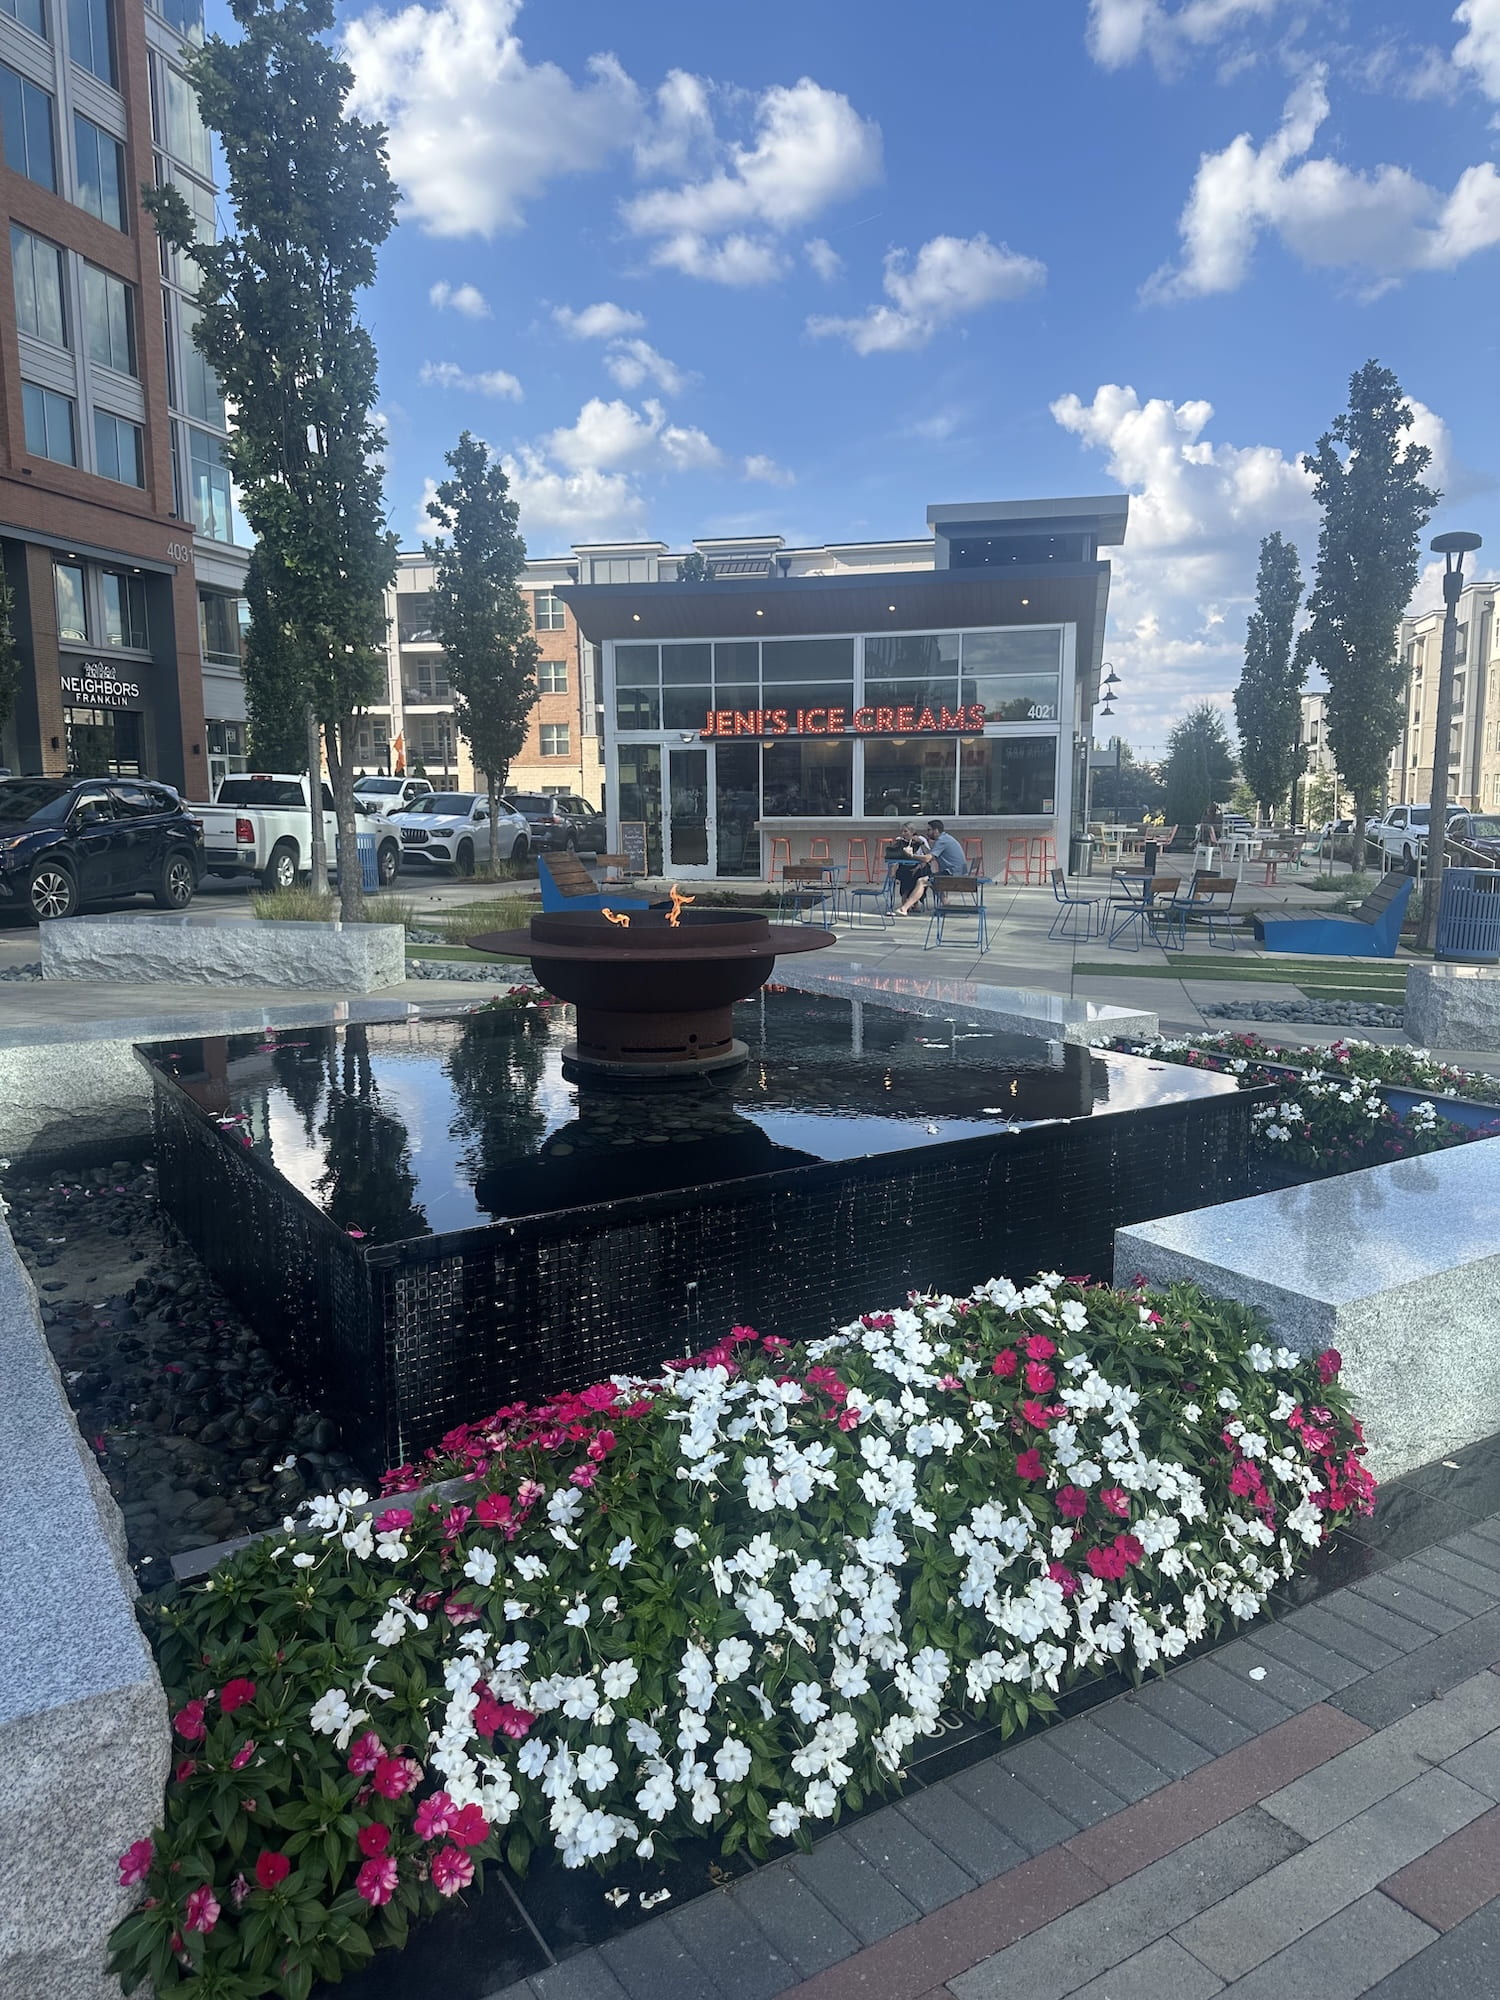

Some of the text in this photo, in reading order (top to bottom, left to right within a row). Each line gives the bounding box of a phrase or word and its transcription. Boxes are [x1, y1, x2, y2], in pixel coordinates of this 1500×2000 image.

[167, 541, 193, 563] 4031
[61, 676, 139, 697] NEIGHBORS
[75, 693, 128, 705] FRANKLIN
[700, 704, 986, 736] JENI'S ICE CREAMS
[1027, 704, 1054, 719] 4021
